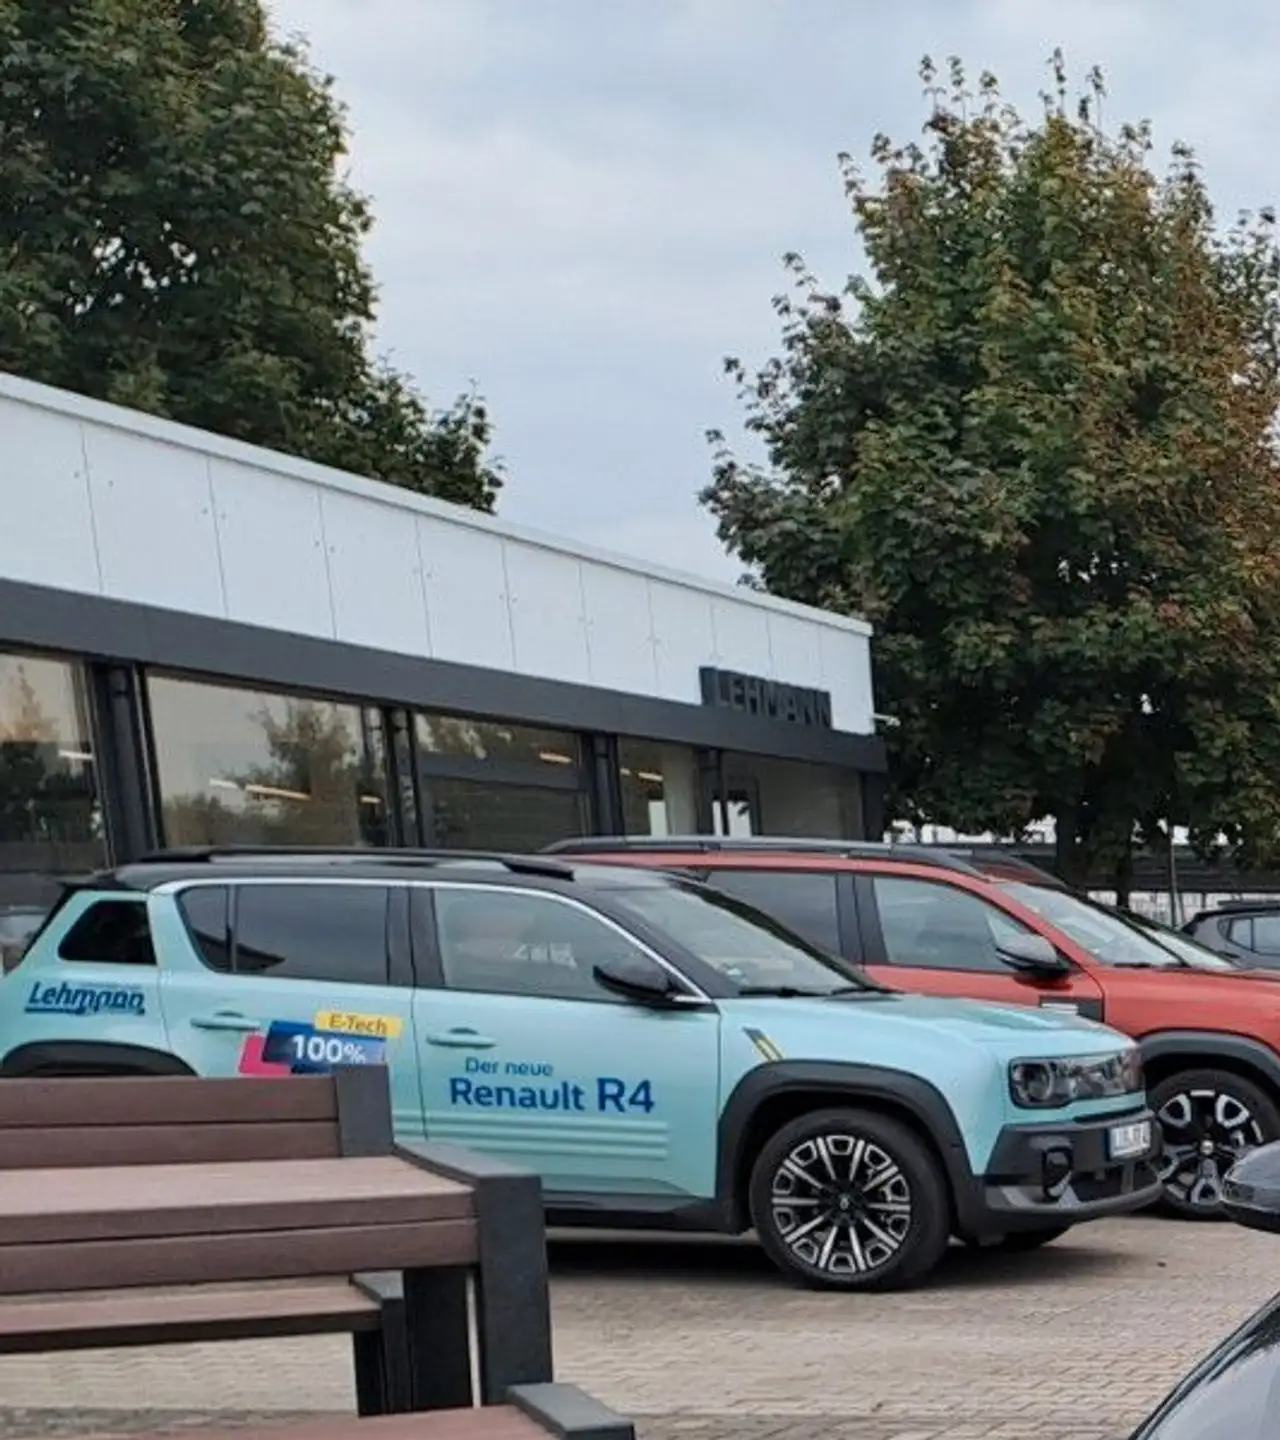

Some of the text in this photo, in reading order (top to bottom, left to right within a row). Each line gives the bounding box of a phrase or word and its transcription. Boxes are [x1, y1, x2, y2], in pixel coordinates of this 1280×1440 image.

[700, 667, 832, 728] LEHMANN
[26, 981, 145, 1014] Lehmann
[330, 1013, 388, 1033] E-Tech
[293, 1034, 367, 1063] 100%
[465, 1056, 554, 1077] Der neue
[449, 1076, 655, 1113] Renault R4
